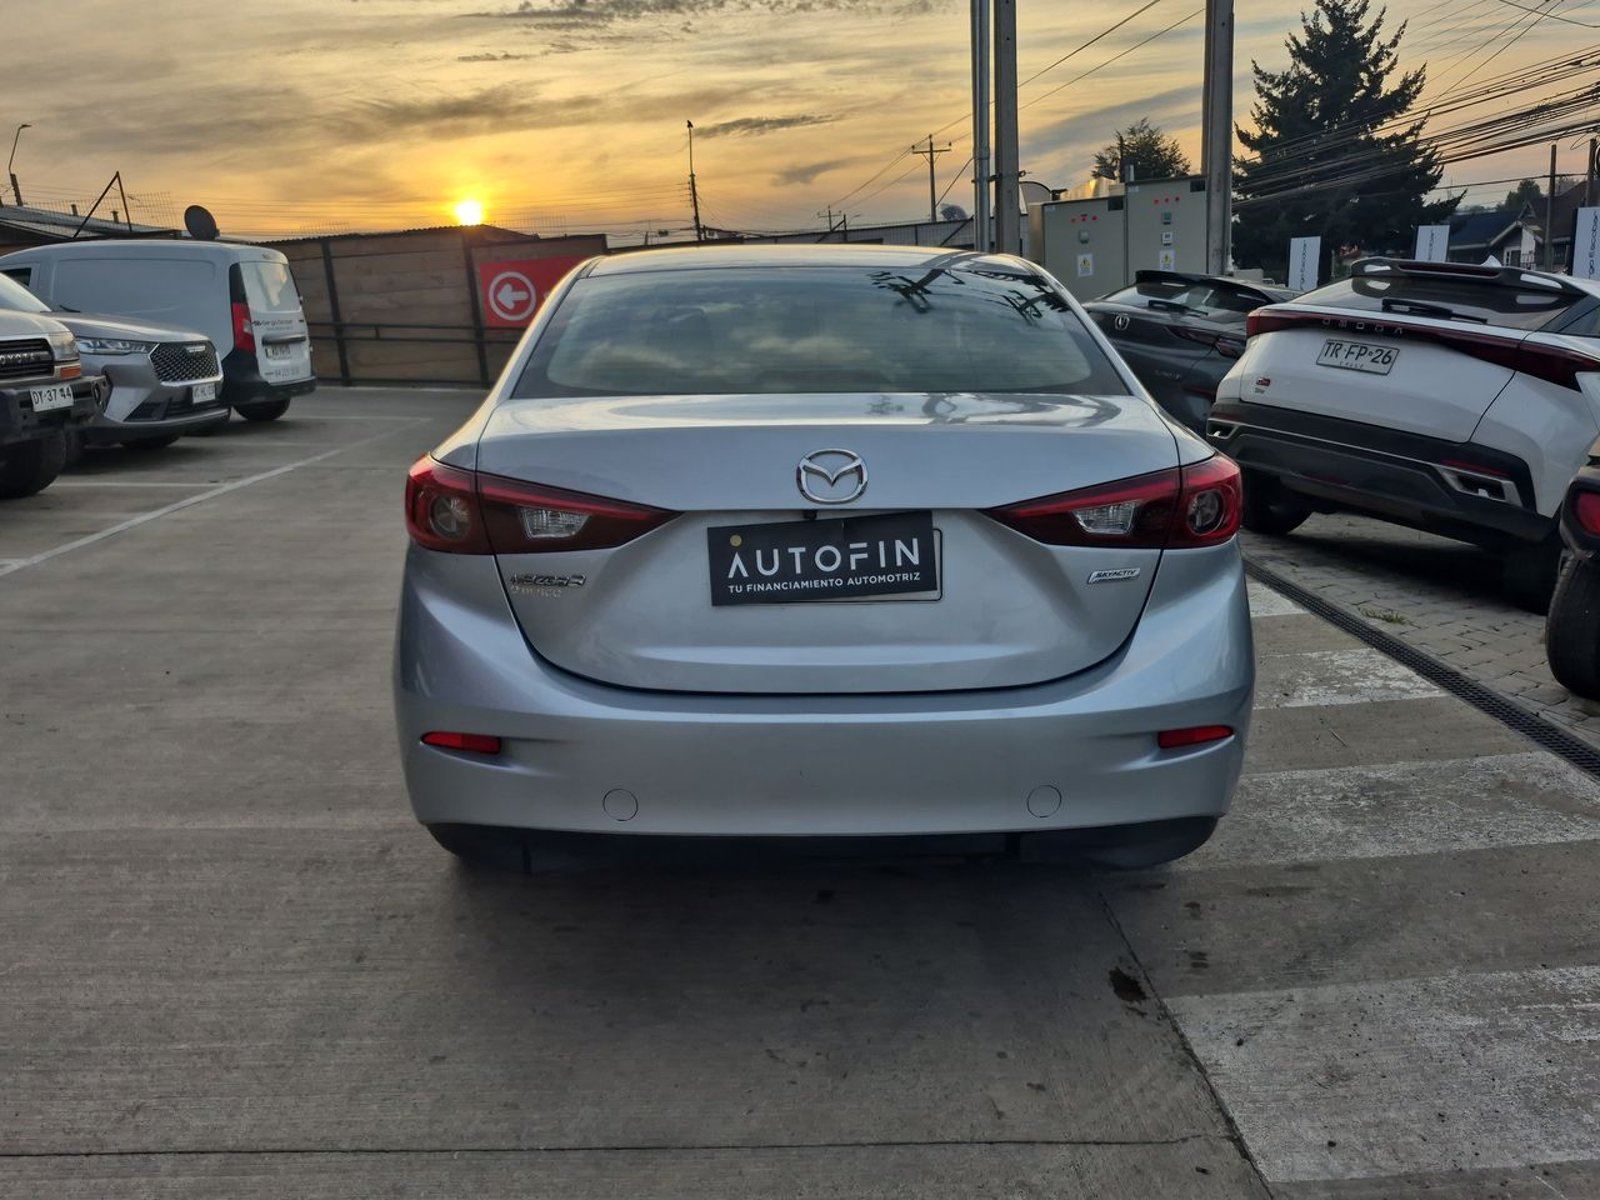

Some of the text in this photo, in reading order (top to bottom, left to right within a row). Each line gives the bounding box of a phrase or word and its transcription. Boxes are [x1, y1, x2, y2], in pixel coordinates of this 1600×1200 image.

[728, 538, 920, 579] AUTOFIN
[728, 572, 921, 593] TU FINANCIAMIENTO AUTOMOTRIZ
